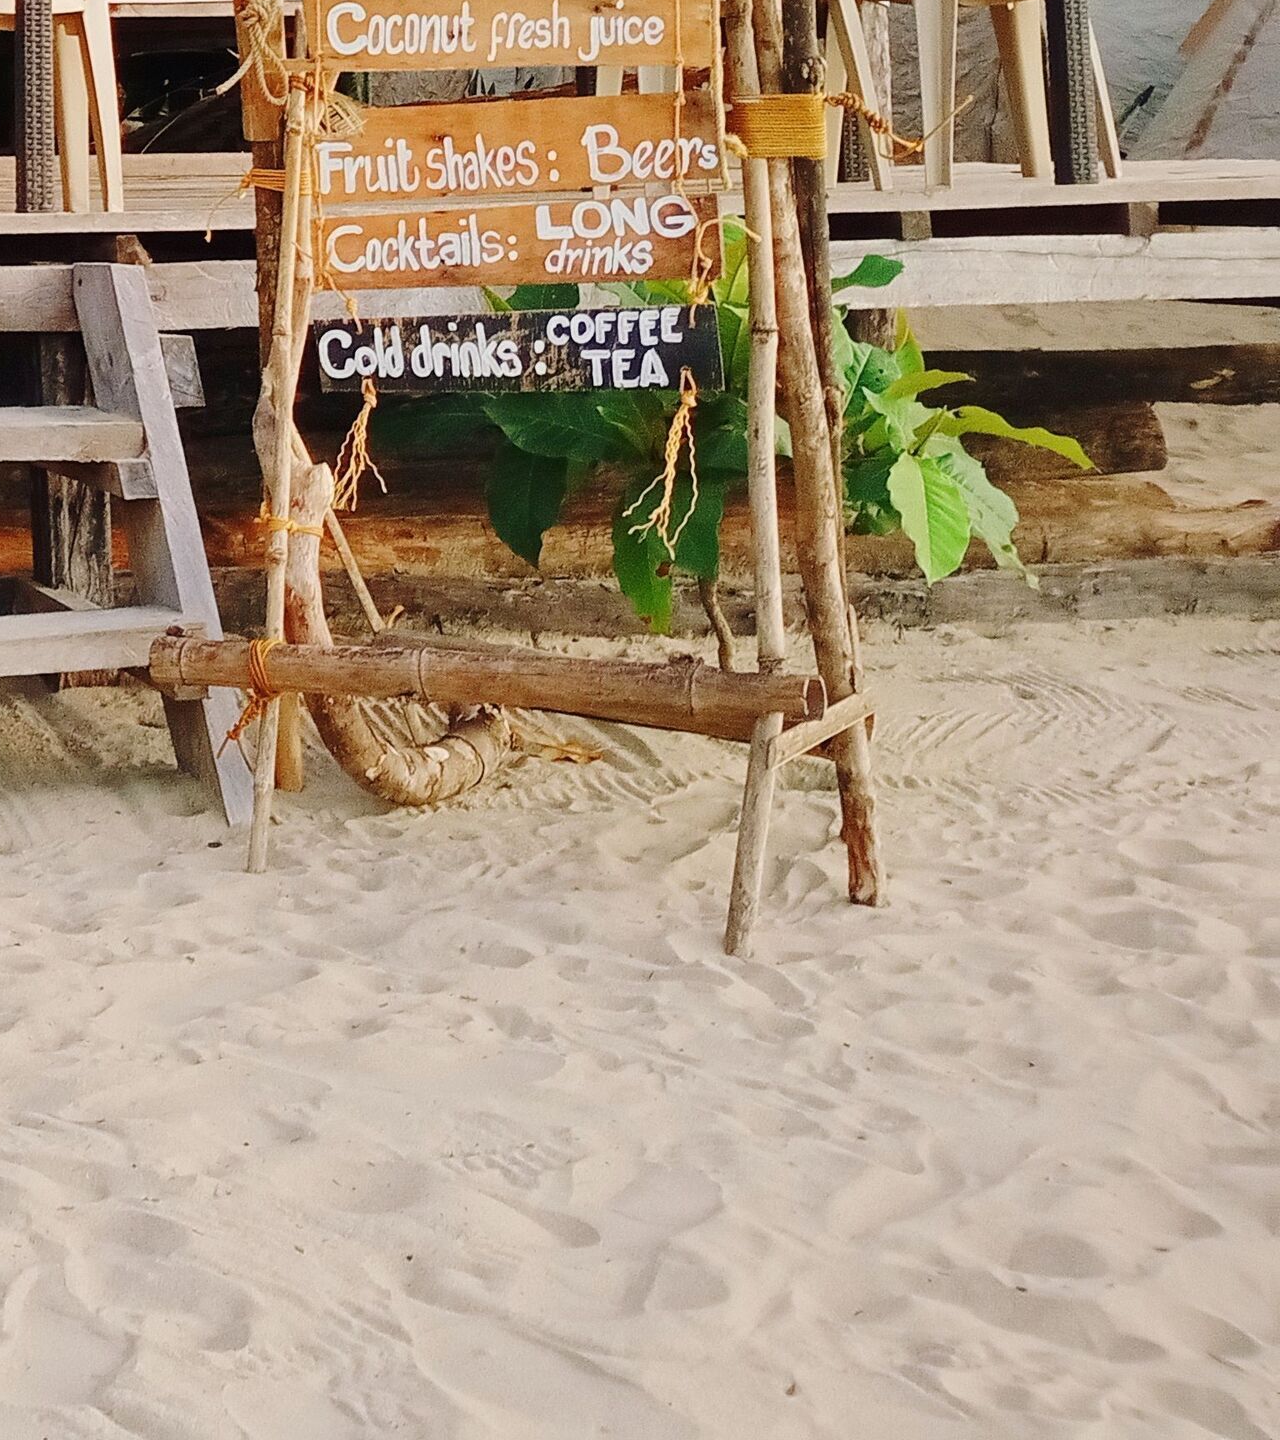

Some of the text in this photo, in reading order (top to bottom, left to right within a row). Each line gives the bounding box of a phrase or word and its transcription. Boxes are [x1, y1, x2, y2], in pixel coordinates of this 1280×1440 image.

[326, 1, 476, 57] Coconut
[487, 0, 571, 62] fresh
[317, 136, 421, 195] Fruit
[583, 123, 718, 188] Beers
[535, 196, 697, 241] LONG
[327, 213, 518, 274] Cocktails:
[544, 236, 653, 277] drinks
[547, 308, 683, 347] COFFEE
[317, 326, 404, 380] Cold
[581, 348, 670, 389] TEA
